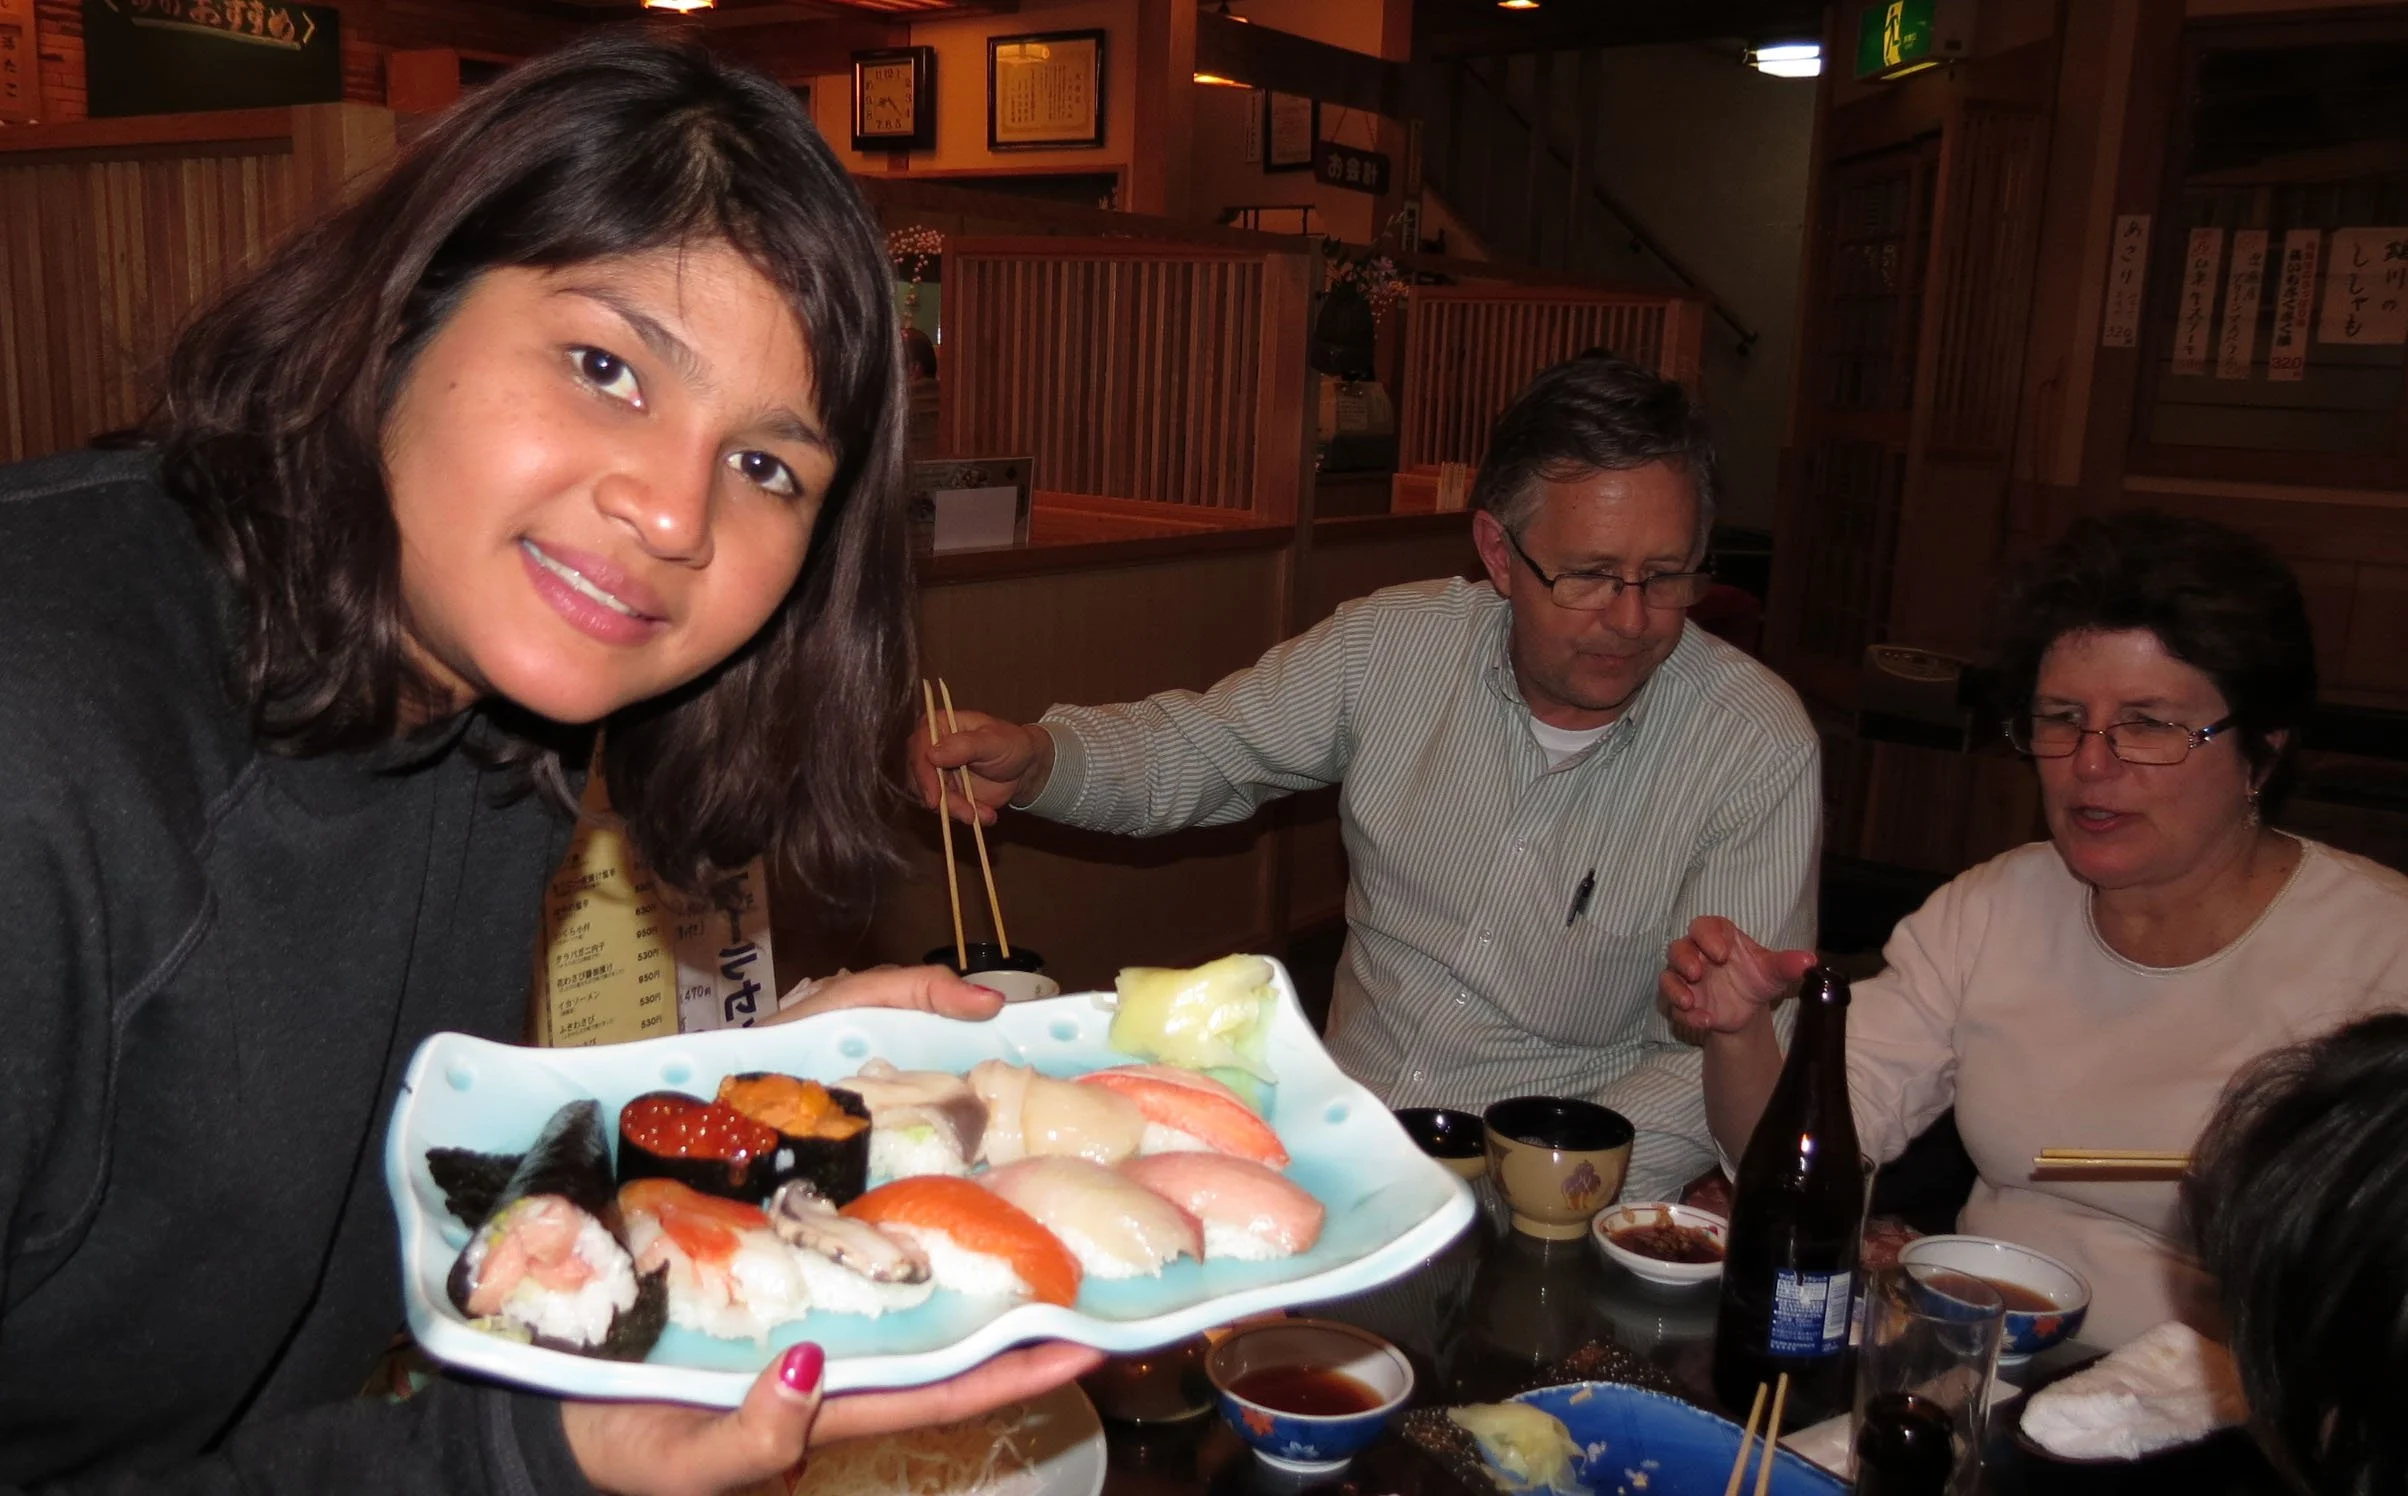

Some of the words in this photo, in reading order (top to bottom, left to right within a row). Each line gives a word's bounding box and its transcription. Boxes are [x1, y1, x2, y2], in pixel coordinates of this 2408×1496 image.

[1326, 151, 1379, 188] お会計
[637, 948, 660, 961] 530円
[640, 992, 662, 1006] 530円
[641, 1015, 663, 1029] 530円
